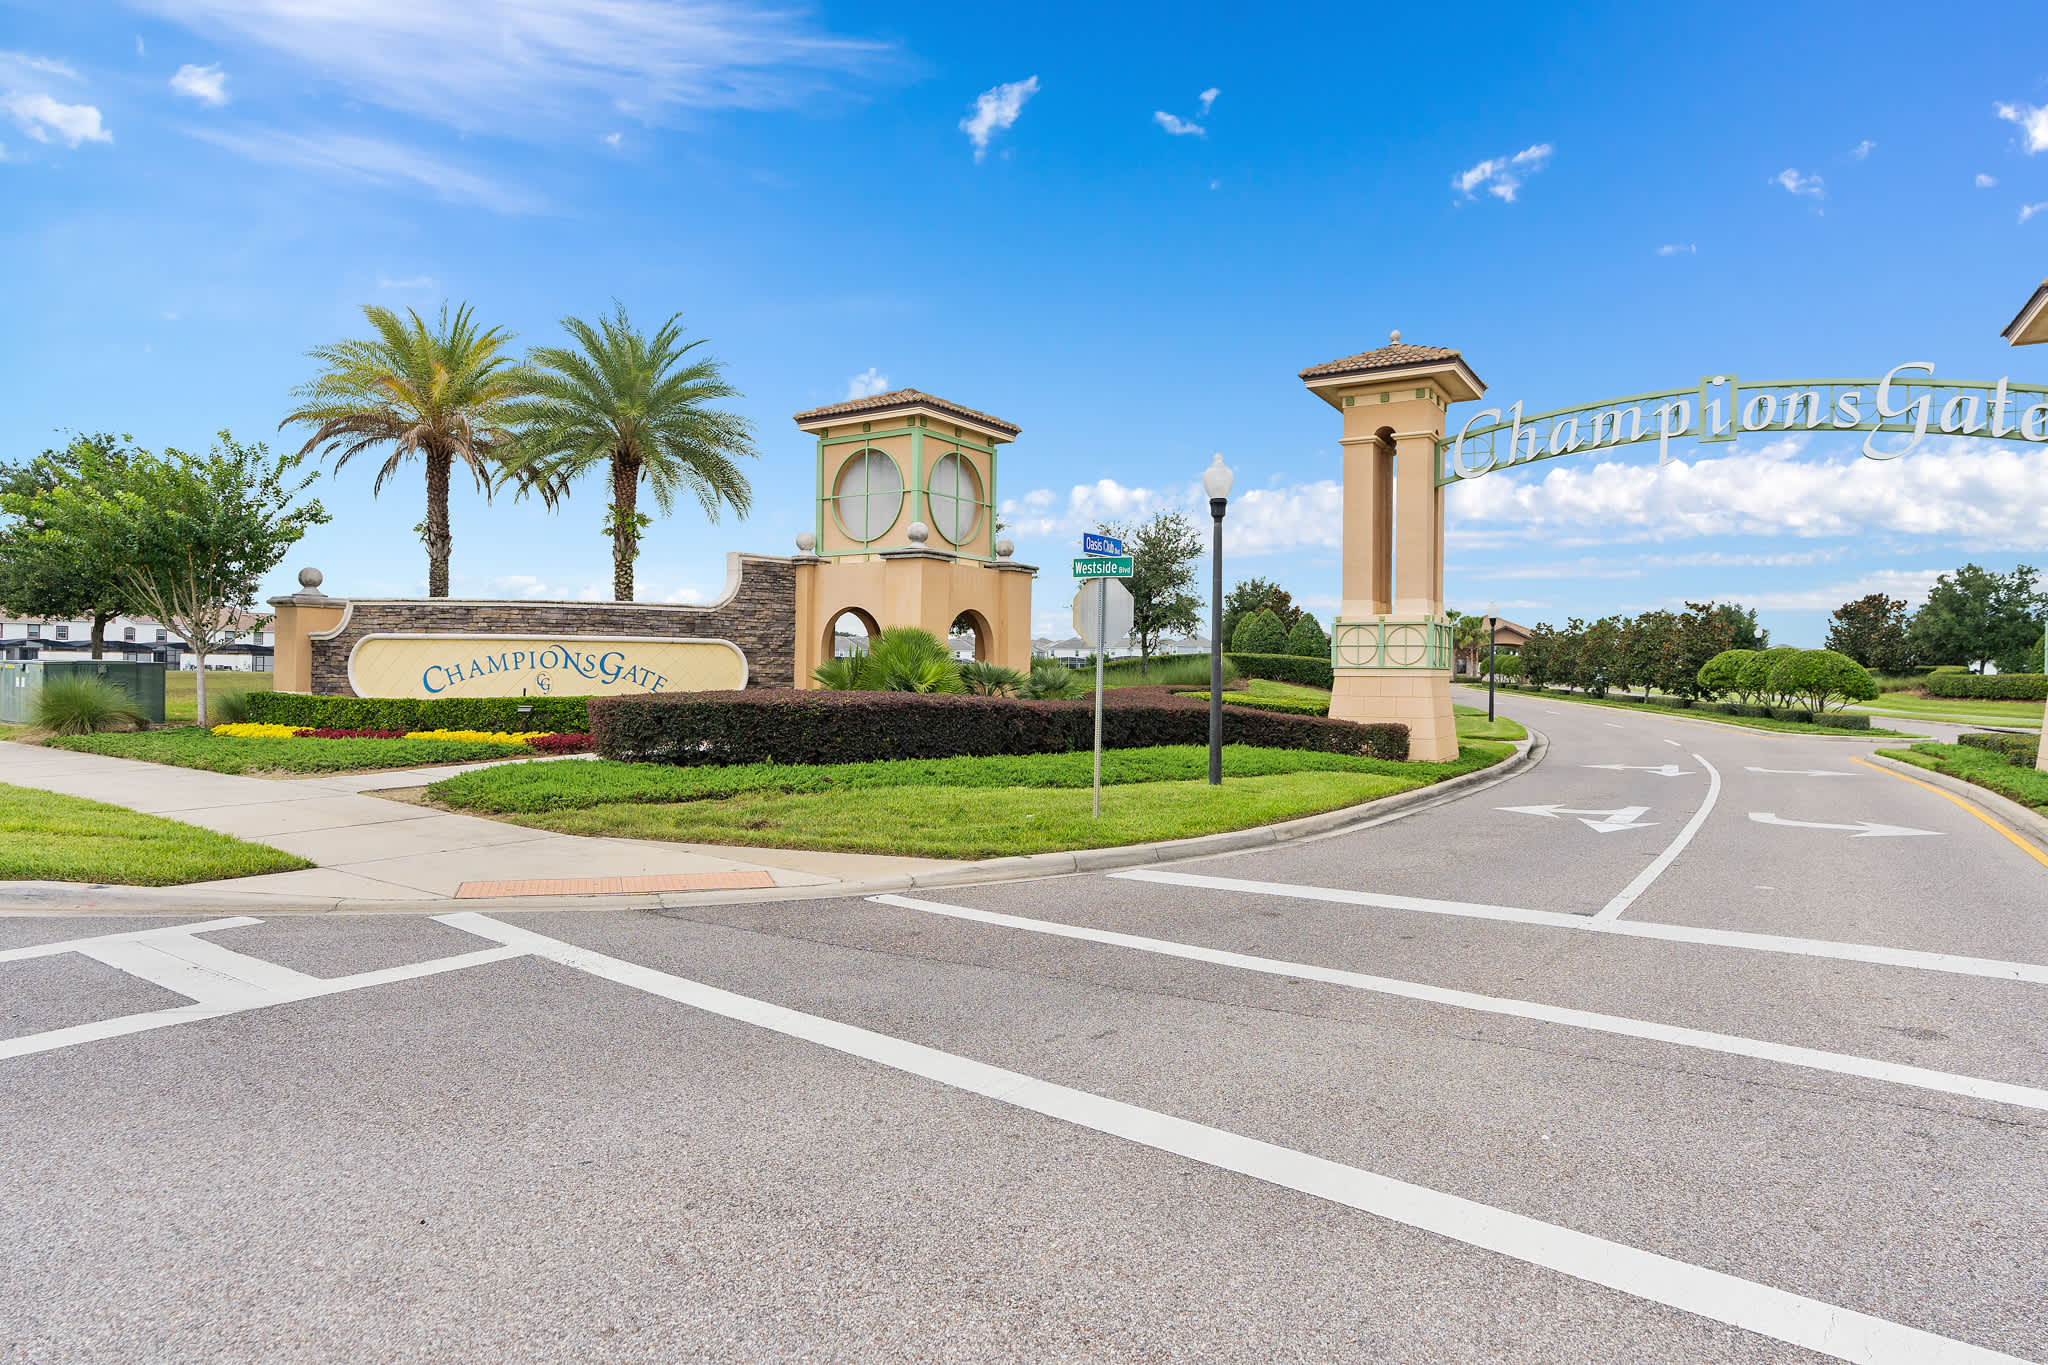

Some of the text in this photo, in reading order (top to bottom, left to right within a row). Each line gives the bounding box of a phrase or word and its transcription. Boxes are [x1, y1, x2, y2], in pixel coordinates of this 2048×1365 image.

[1453, 361, 2048, 479] ChampionsGate
[1086, 537, 1103, 551] Oasis
[1075, 561, 1117, 574] Westside
